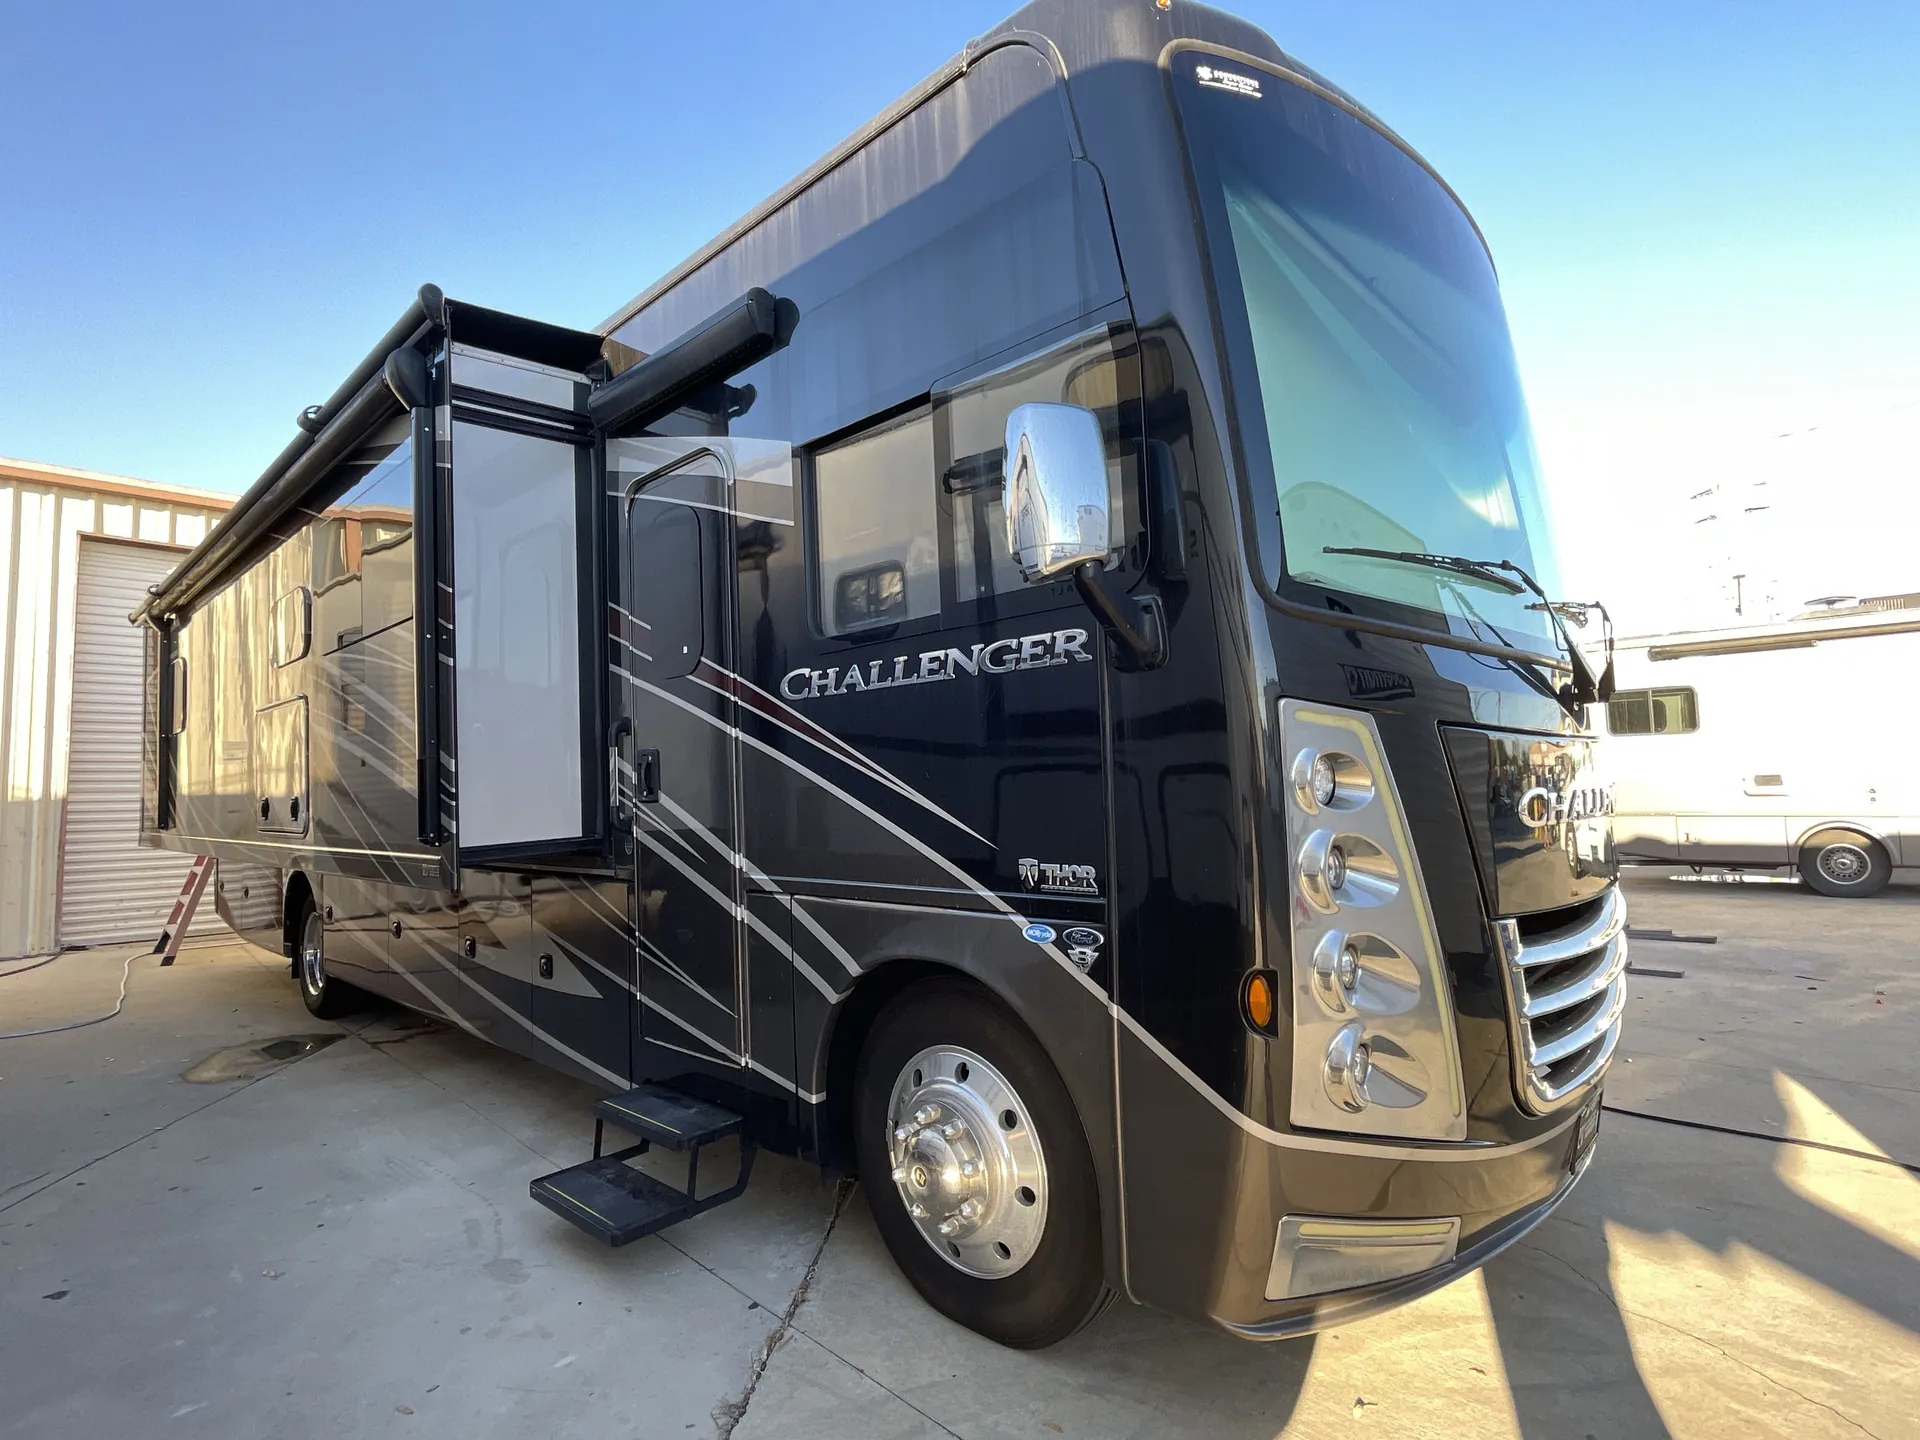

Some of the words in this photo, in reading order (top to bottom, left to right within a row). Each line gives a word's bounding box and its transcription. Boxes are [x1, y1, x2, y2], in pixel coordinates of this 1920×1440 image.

[779, 628, 1093, 700] CHALLENGER
[1039, 863, 1097, 889] THOR
[1070, 931, 1094, 944] Ford
